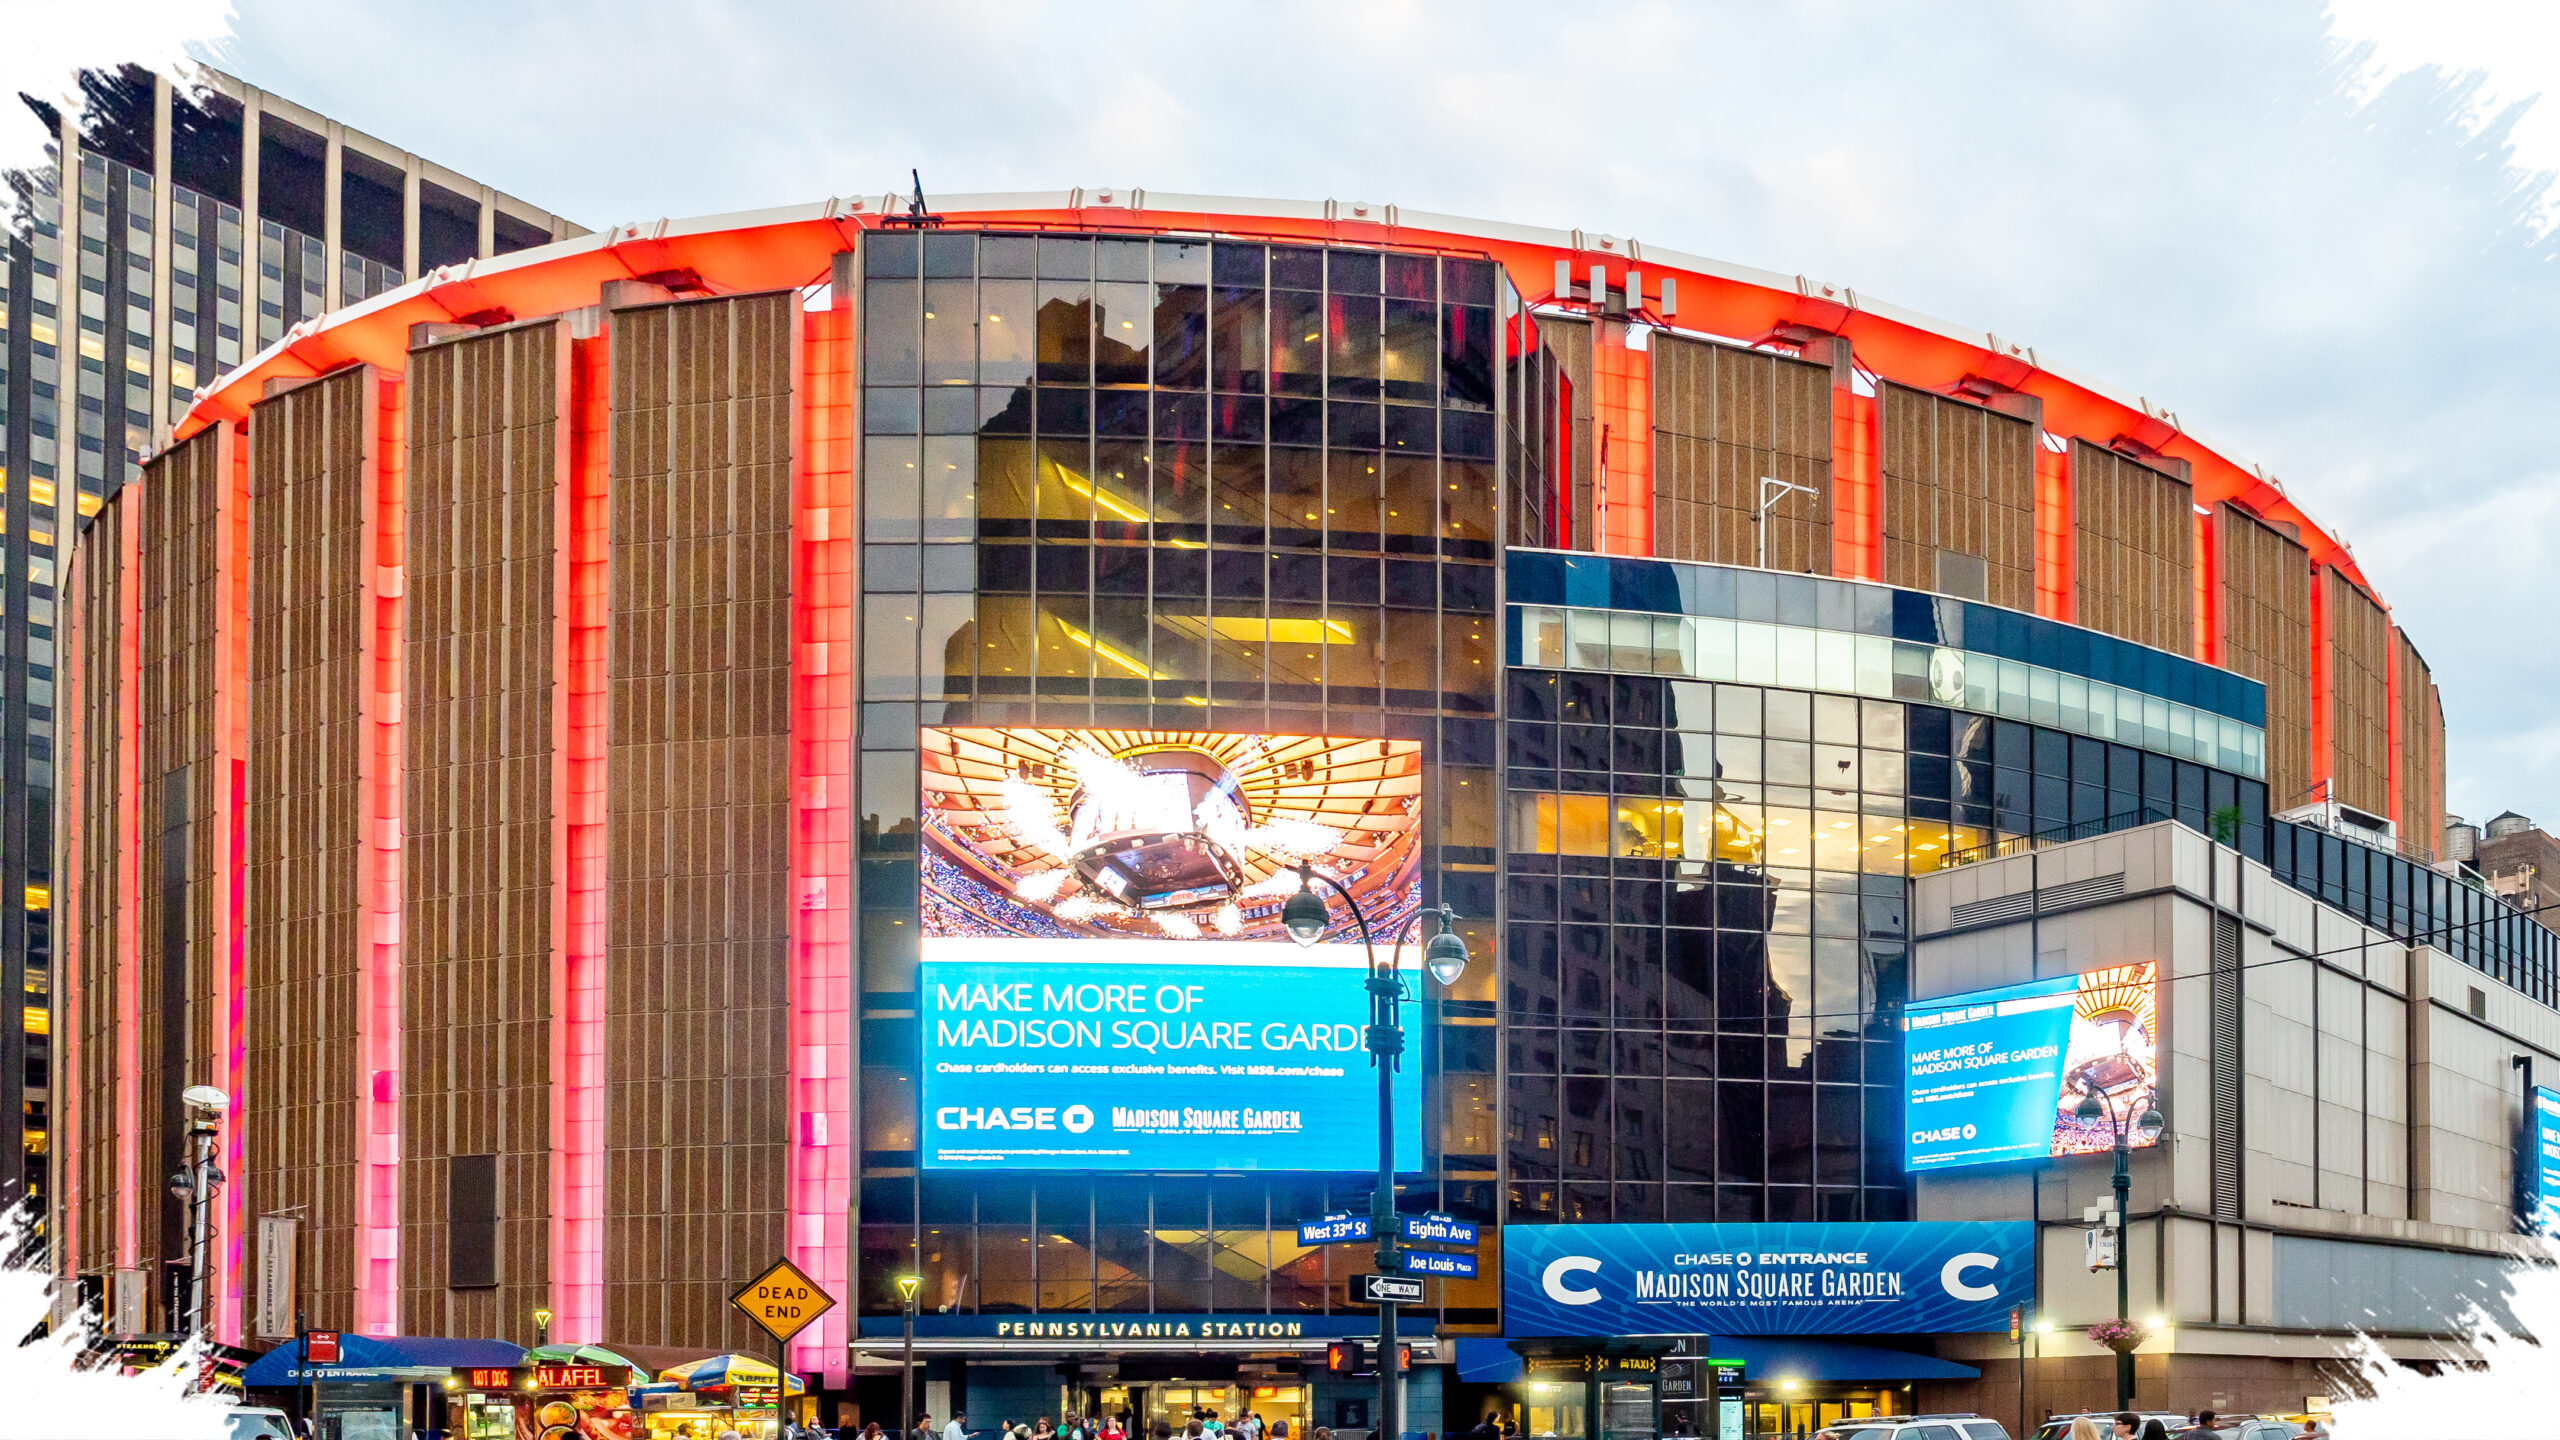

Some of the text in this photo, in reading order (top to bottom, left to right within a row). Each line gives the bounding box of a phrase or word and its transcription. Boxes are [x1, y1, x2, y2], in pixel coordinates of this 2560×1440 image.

[937, 983, 1205, 1013] MAKE MORE OF
[937, 1019, 1372, 1055] MADISON SQUARE GARDE
[1911, 1042, 1994, 1064] MAKE MORE OF
[1911, 1045, 2059, 1077] MADISON SQUARE GARDEN
[936, 1062, 1345, 1077] Chase cardholders can access exclusive benefits. Visit MSG.com/chase
[936, 1106, 1057, 1131] CHASE
[1112, 1106, 1180, 1129] MADISON
[1182, 1106, 1240, 1131] SQUARE
[1911, 1127, 1961, 1144] CHASE
[1303, 1221, 1367, 1240] West 33rd St
[1409, 1221, 1472, 1241] Eighth Ave
[1409, 1256, 1472, 1272] Joe Louis Plaza
[1674, 1252, 1868, 1266] CHASE ENTRANCE
[1541, 1255, 1602, 1306] C
[1636, 1270, 1729, 1298] MADISON
[1736, 1269, 1815, 1299] SQUARE
[1941, 1252, 2000, 1302] C
[758, 1286, 808, 1300] DEAD
[1375, 1283, 1415, 1294] ONE WAY
[765, 1305, 801, 1318] END
[998, 1322, 1303, 1338] PENNSYLVANIA STATION
[1629, 1359, 1649, 1369] TAXI
[473, 1370, 508, 1386] HOT DOG
[1662, 1379, 1692, 1392] GARDEN
